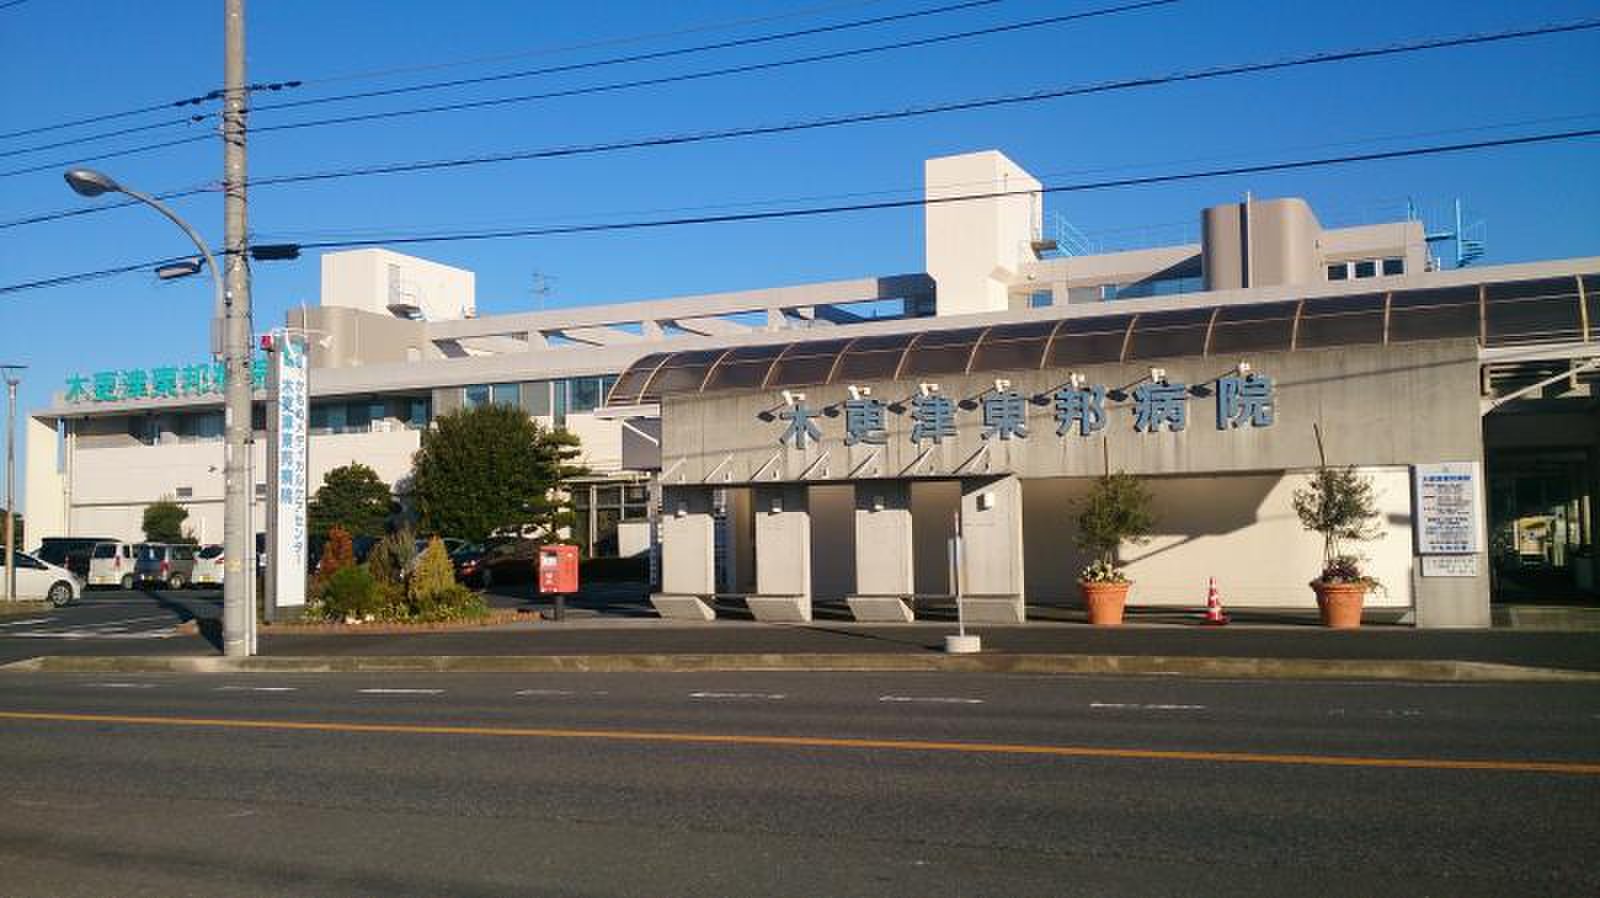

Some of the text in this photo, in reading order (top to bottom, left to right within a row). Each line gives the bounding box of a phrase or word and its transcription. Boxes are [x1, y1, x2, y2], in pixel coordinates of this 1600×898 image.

[281, 379, 294, 504] 木更津東邦病院
[778, 376, 1276, 448] 木更津東邦病院
